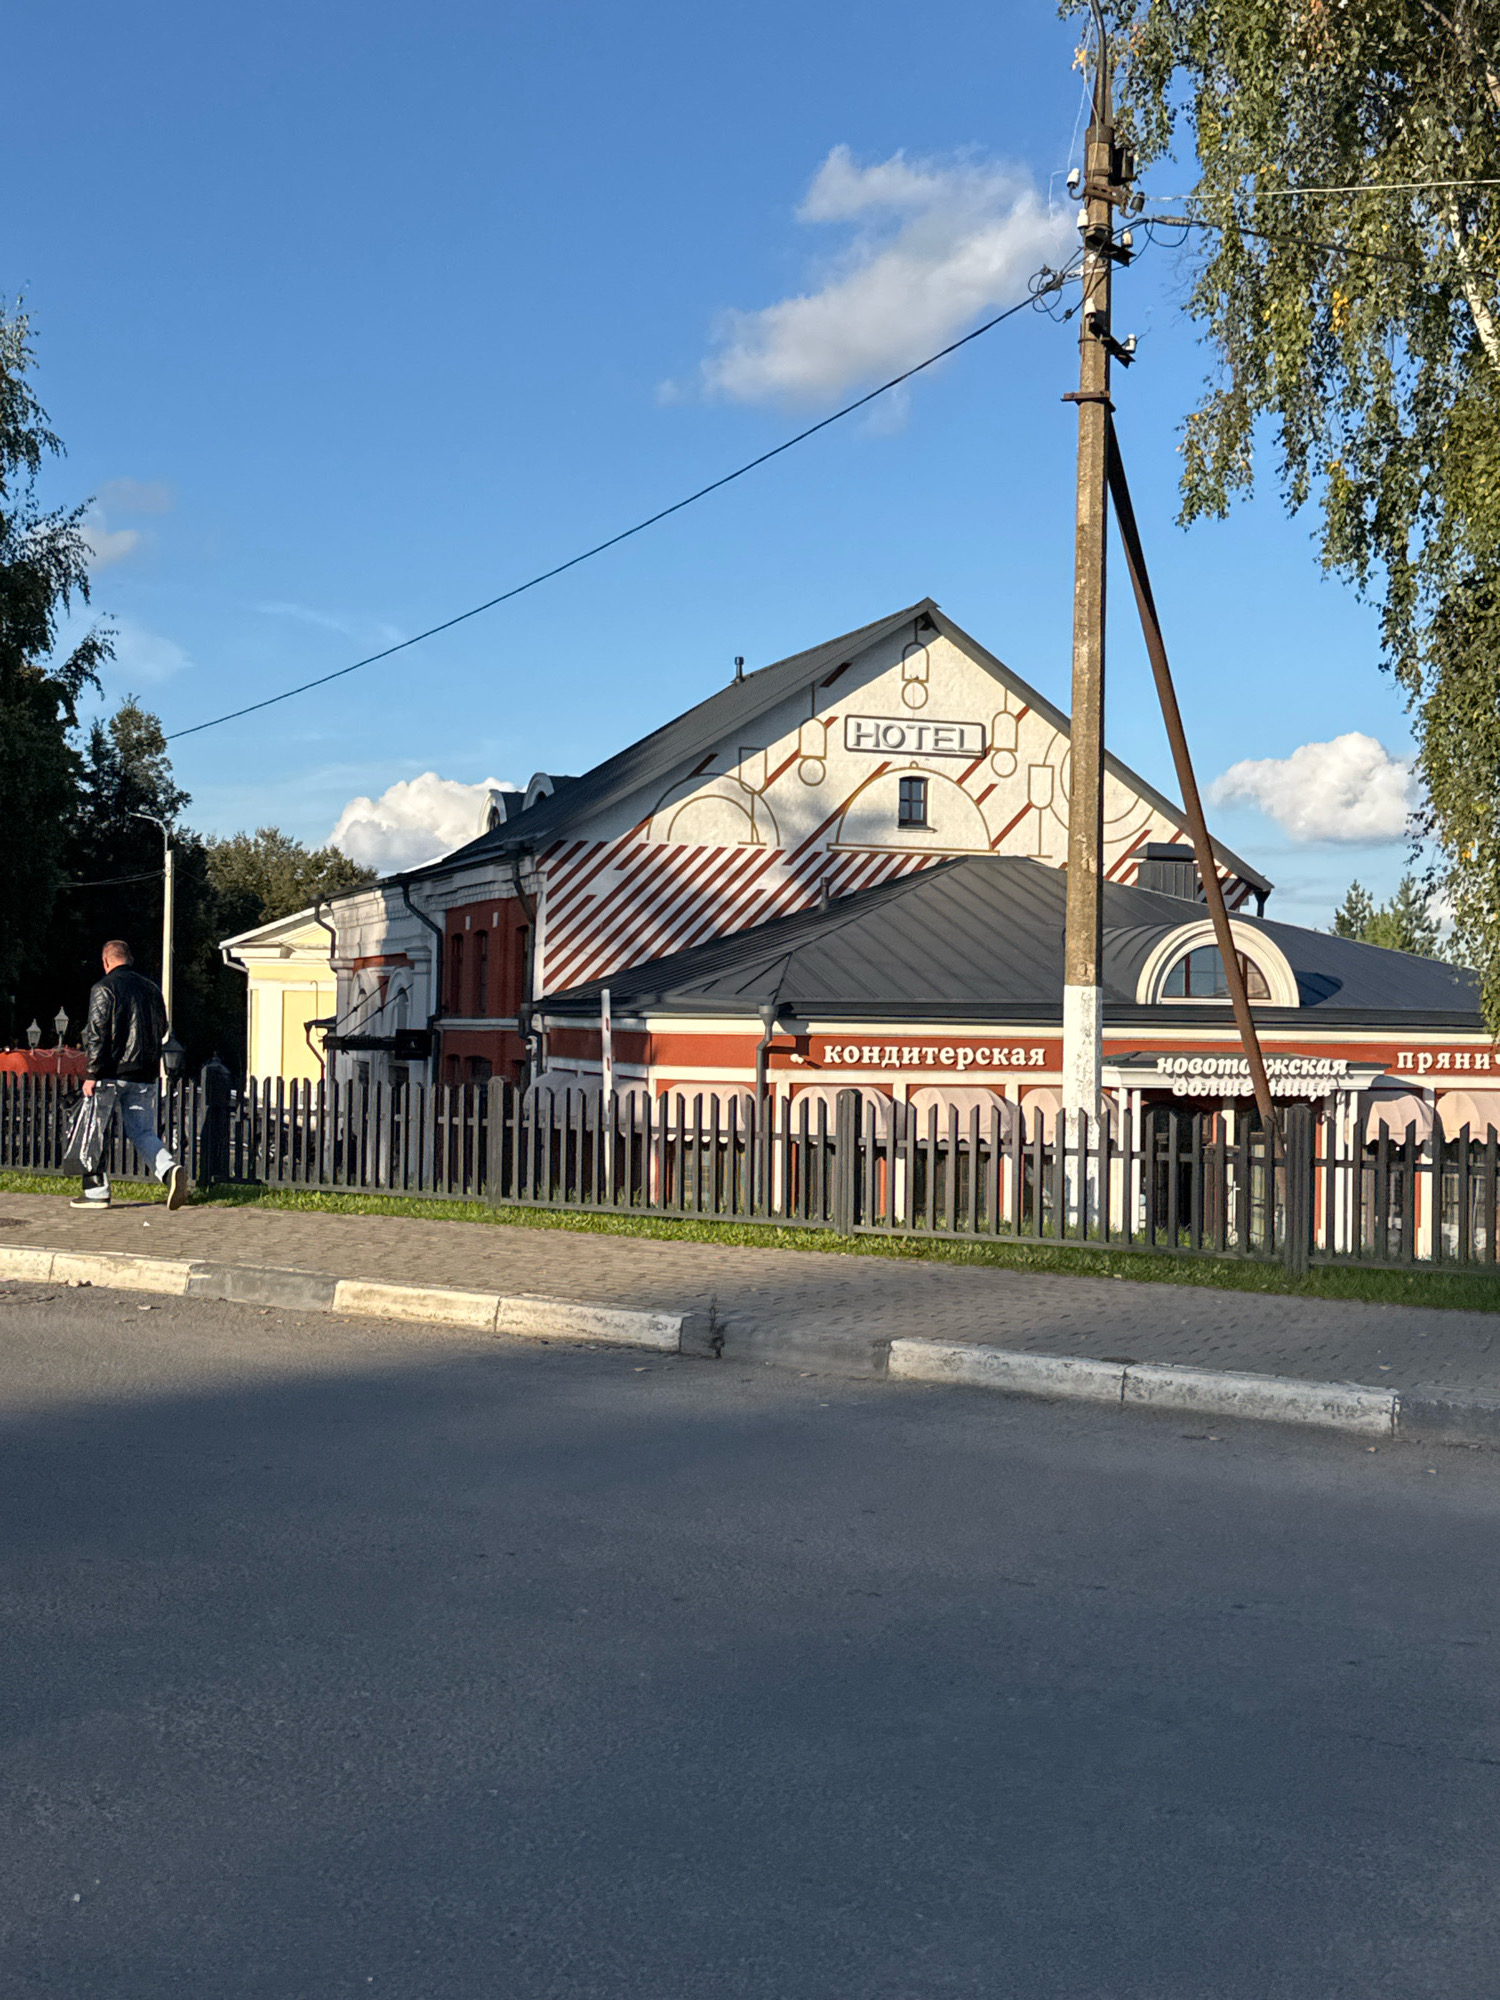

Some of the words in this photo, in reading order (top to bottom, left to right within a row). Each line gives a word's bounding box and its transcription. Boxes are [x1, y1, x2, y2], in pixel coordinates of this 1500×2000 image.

[853, 721, 981, 752] HOTEL
[823, 1045, 1045, 1070] кондитерская
[1172, 1077, 1332, 1102] волшеница
